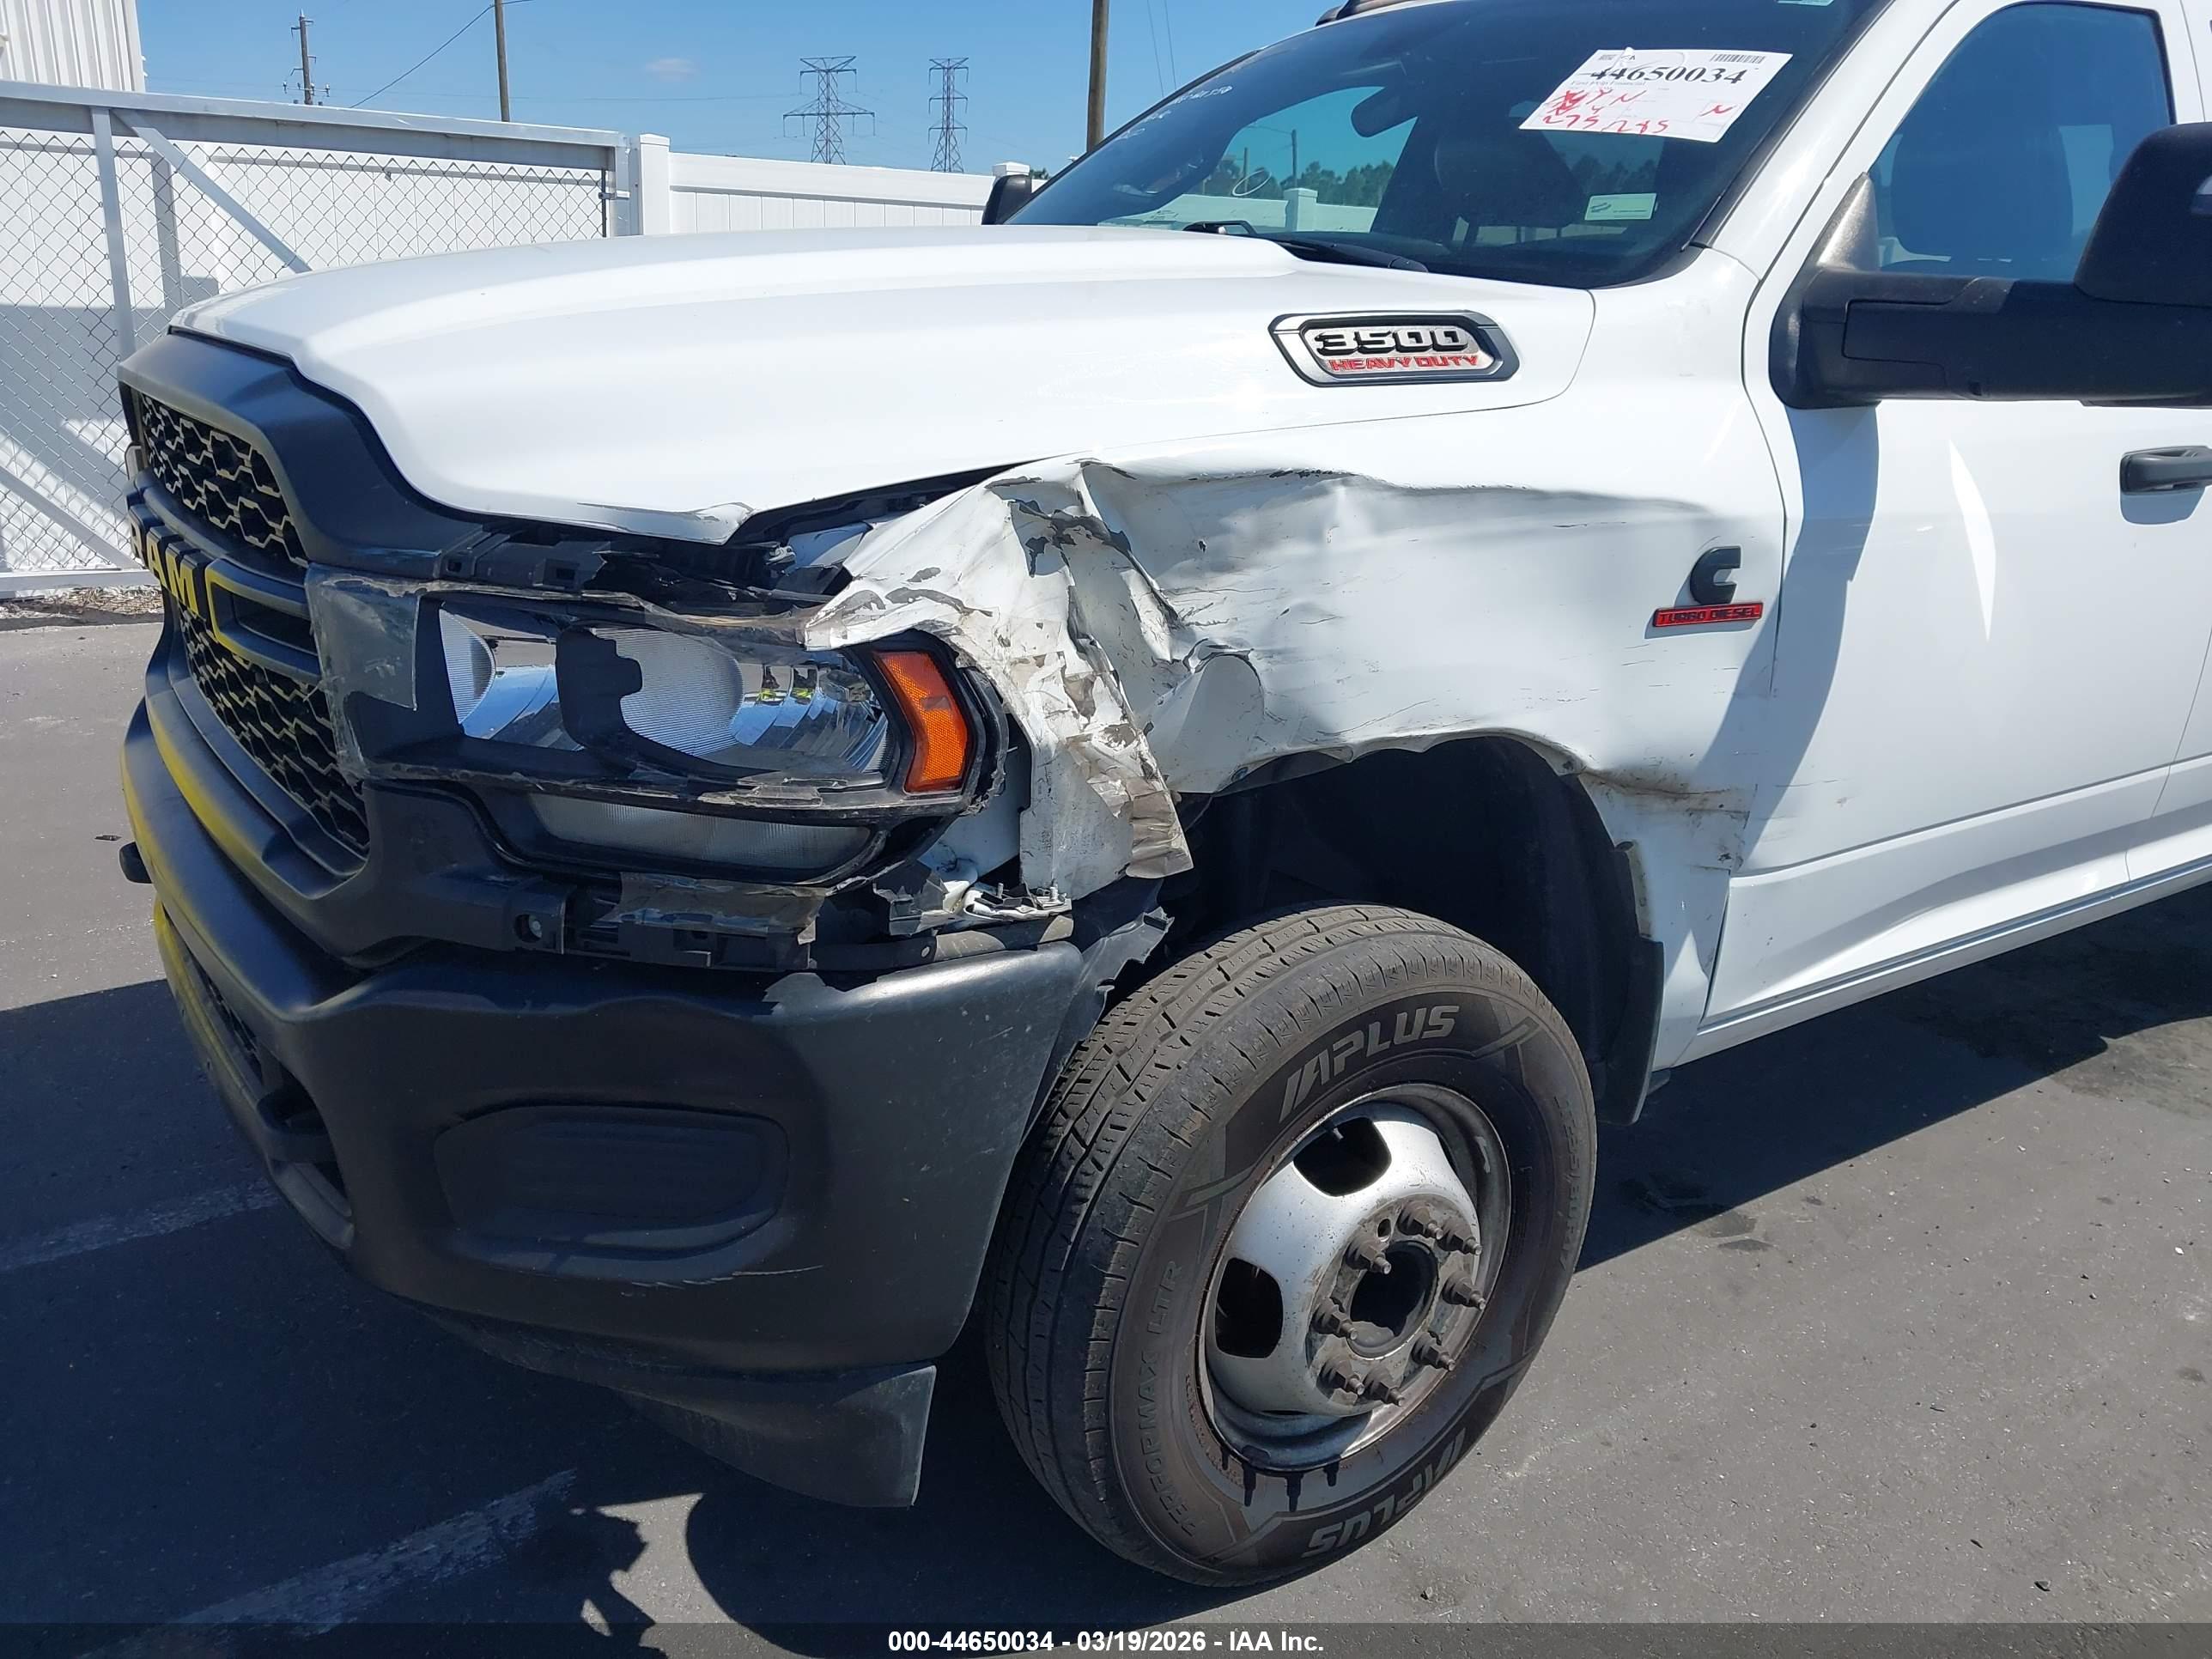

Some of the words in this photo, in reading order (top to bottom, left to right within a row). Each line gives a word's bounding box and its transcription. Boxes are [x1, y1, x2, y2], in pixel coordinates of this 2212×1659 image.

[1590, 66, 1747, 84] 44650034
[1314, 328, 1469, 356] 3500
[1328, 356, 1413, 371] HEAVY
[1416, 355, 1478, 368] DUTY
[130, 507, 199, 619] RAM
[1660, 611, 1705, 625] TURBO
[1710, 605, 1761, 619] DIESEL
[1146, 1260, 1182, 1335] LTR
